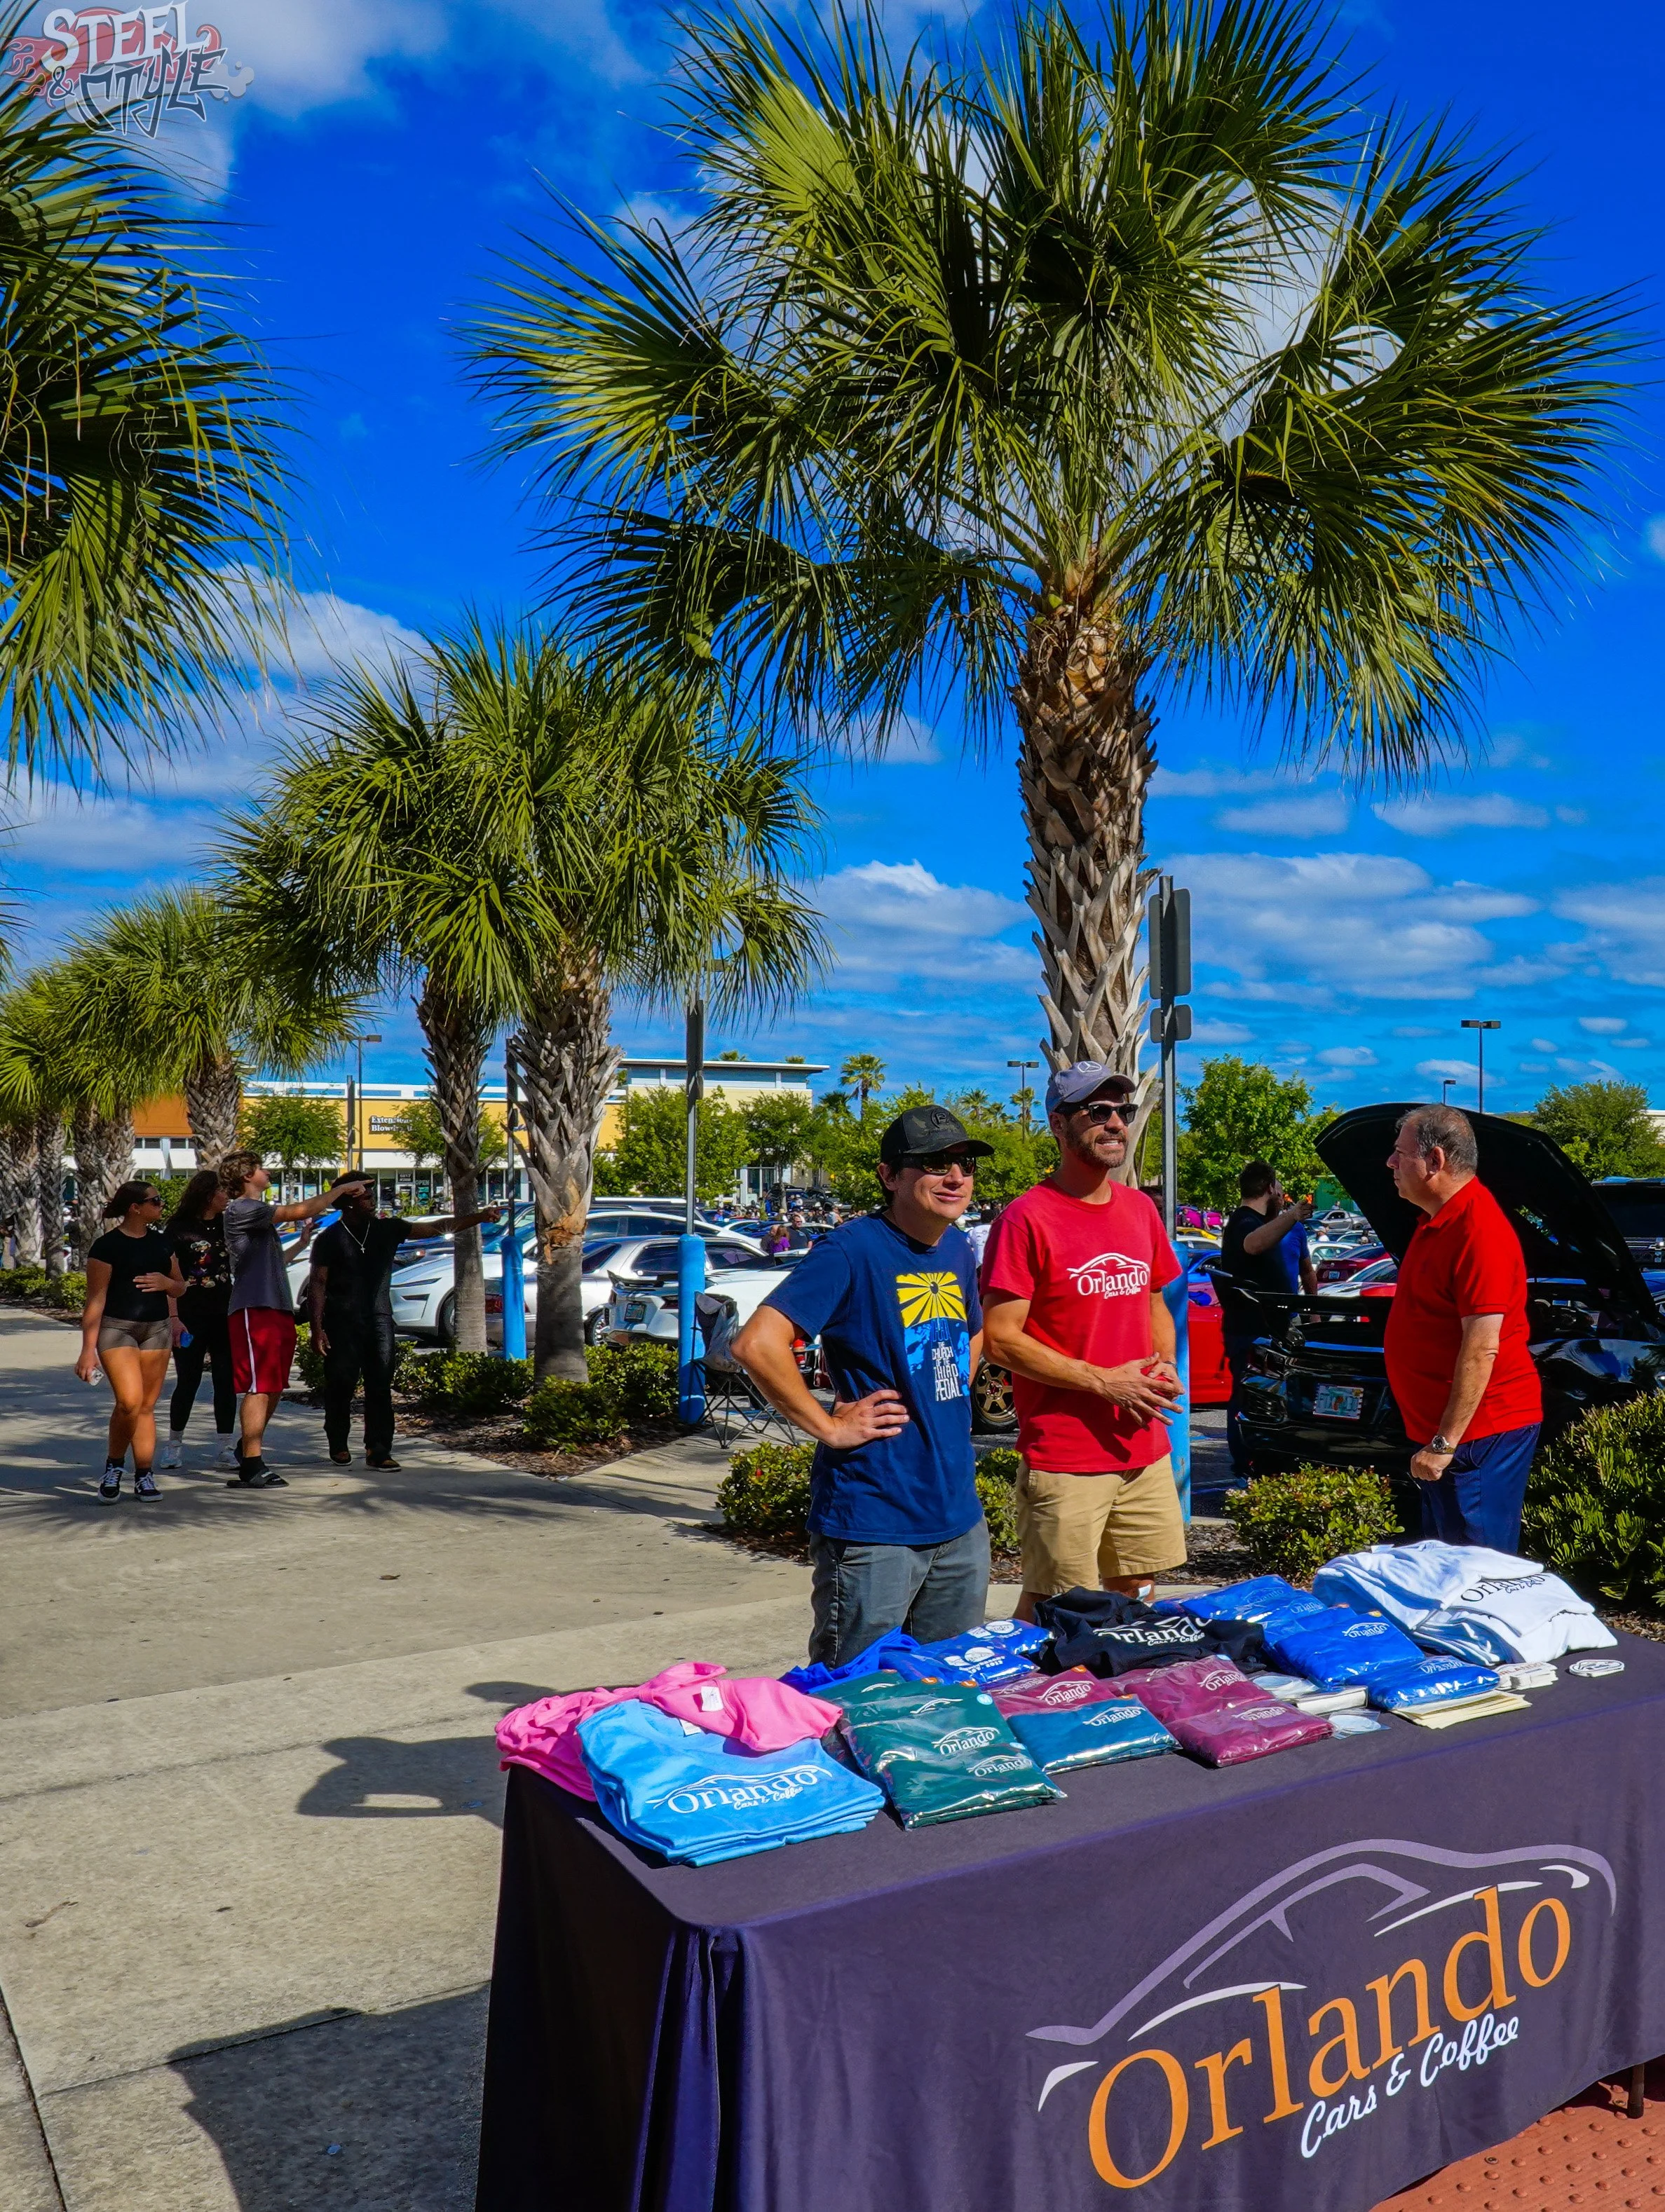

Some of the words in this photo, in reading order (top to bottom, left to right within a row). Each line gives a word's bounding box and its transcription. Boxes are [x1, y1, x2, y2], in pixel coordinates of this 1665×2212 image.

[1078, 1267, 1148, 1296] Orlando
[932, 1346, 954, 1360] CHURCH
[933, 1363, 959, 1379] THIRD
[935, 1378, 963, 1402] PEDAL
[1348, 1624, 1387, 1638] Orlando
[1045, 1684, 1092, 1706] Orlando
[1091, 1708, 1142, 1726] Orlando
[940, 1730, 995, 1755] Orlando
[974, 1759, 1033, 1777] Orlando
[668, 1770, 818, 1814] Orlando
[733, 1800, 759, 1810] Cars
[773, 1787, 803, 1802] Coffee
[1088, 1885, 1572, 2189] Orlando
[1300, 2083, 1377, 2159] Cars
[1386, 2054, 1411, 2098] &
[1420, 2013, 1520, 2087] Coffee
